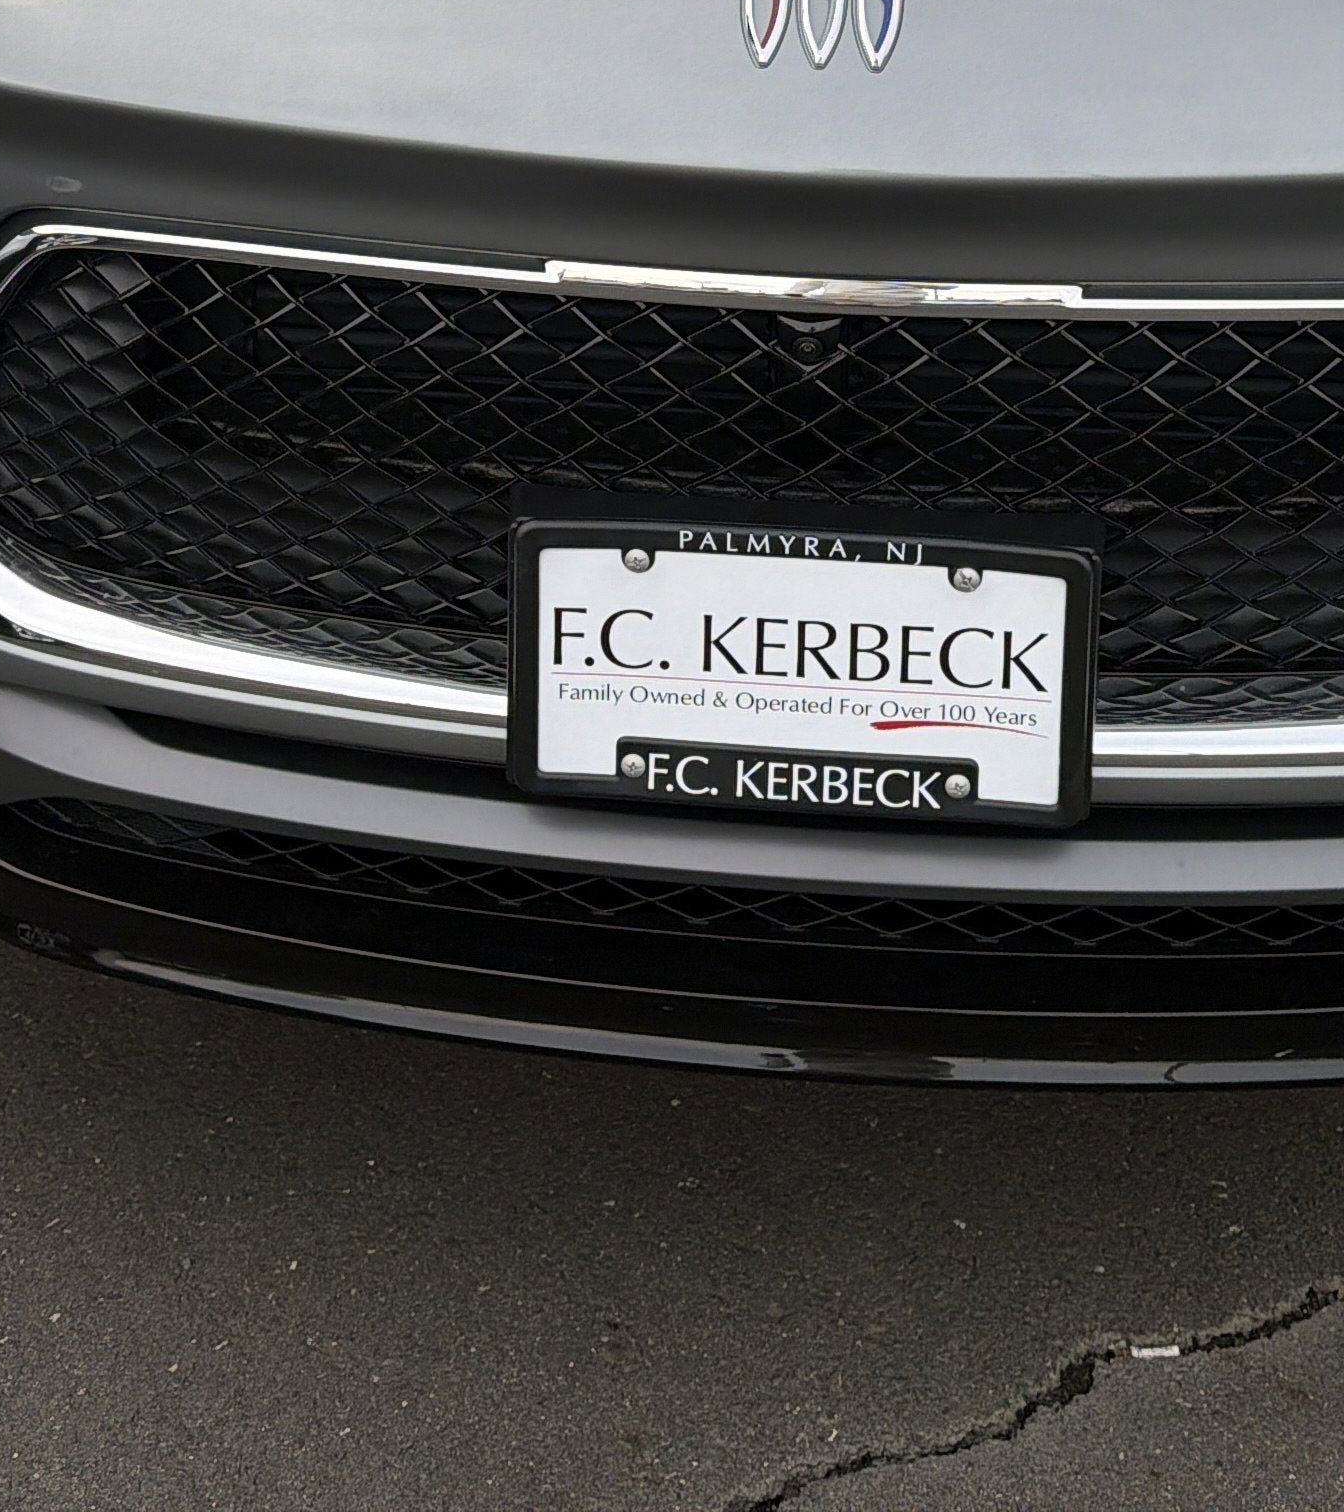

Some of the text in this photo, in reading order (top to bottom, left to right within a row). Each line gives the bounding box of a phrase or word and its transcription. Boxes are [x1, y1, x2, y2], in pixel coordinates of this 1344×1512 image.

[679, 529, 925, 567] PALMYRA, NJ
[552, 606, 1050, 693] F.C. KERBECK
[558, 682, 1038, 727] Family Owned & Operated For Over 100 Years
[646, 752, 942, 810] F.C. KERBECK
